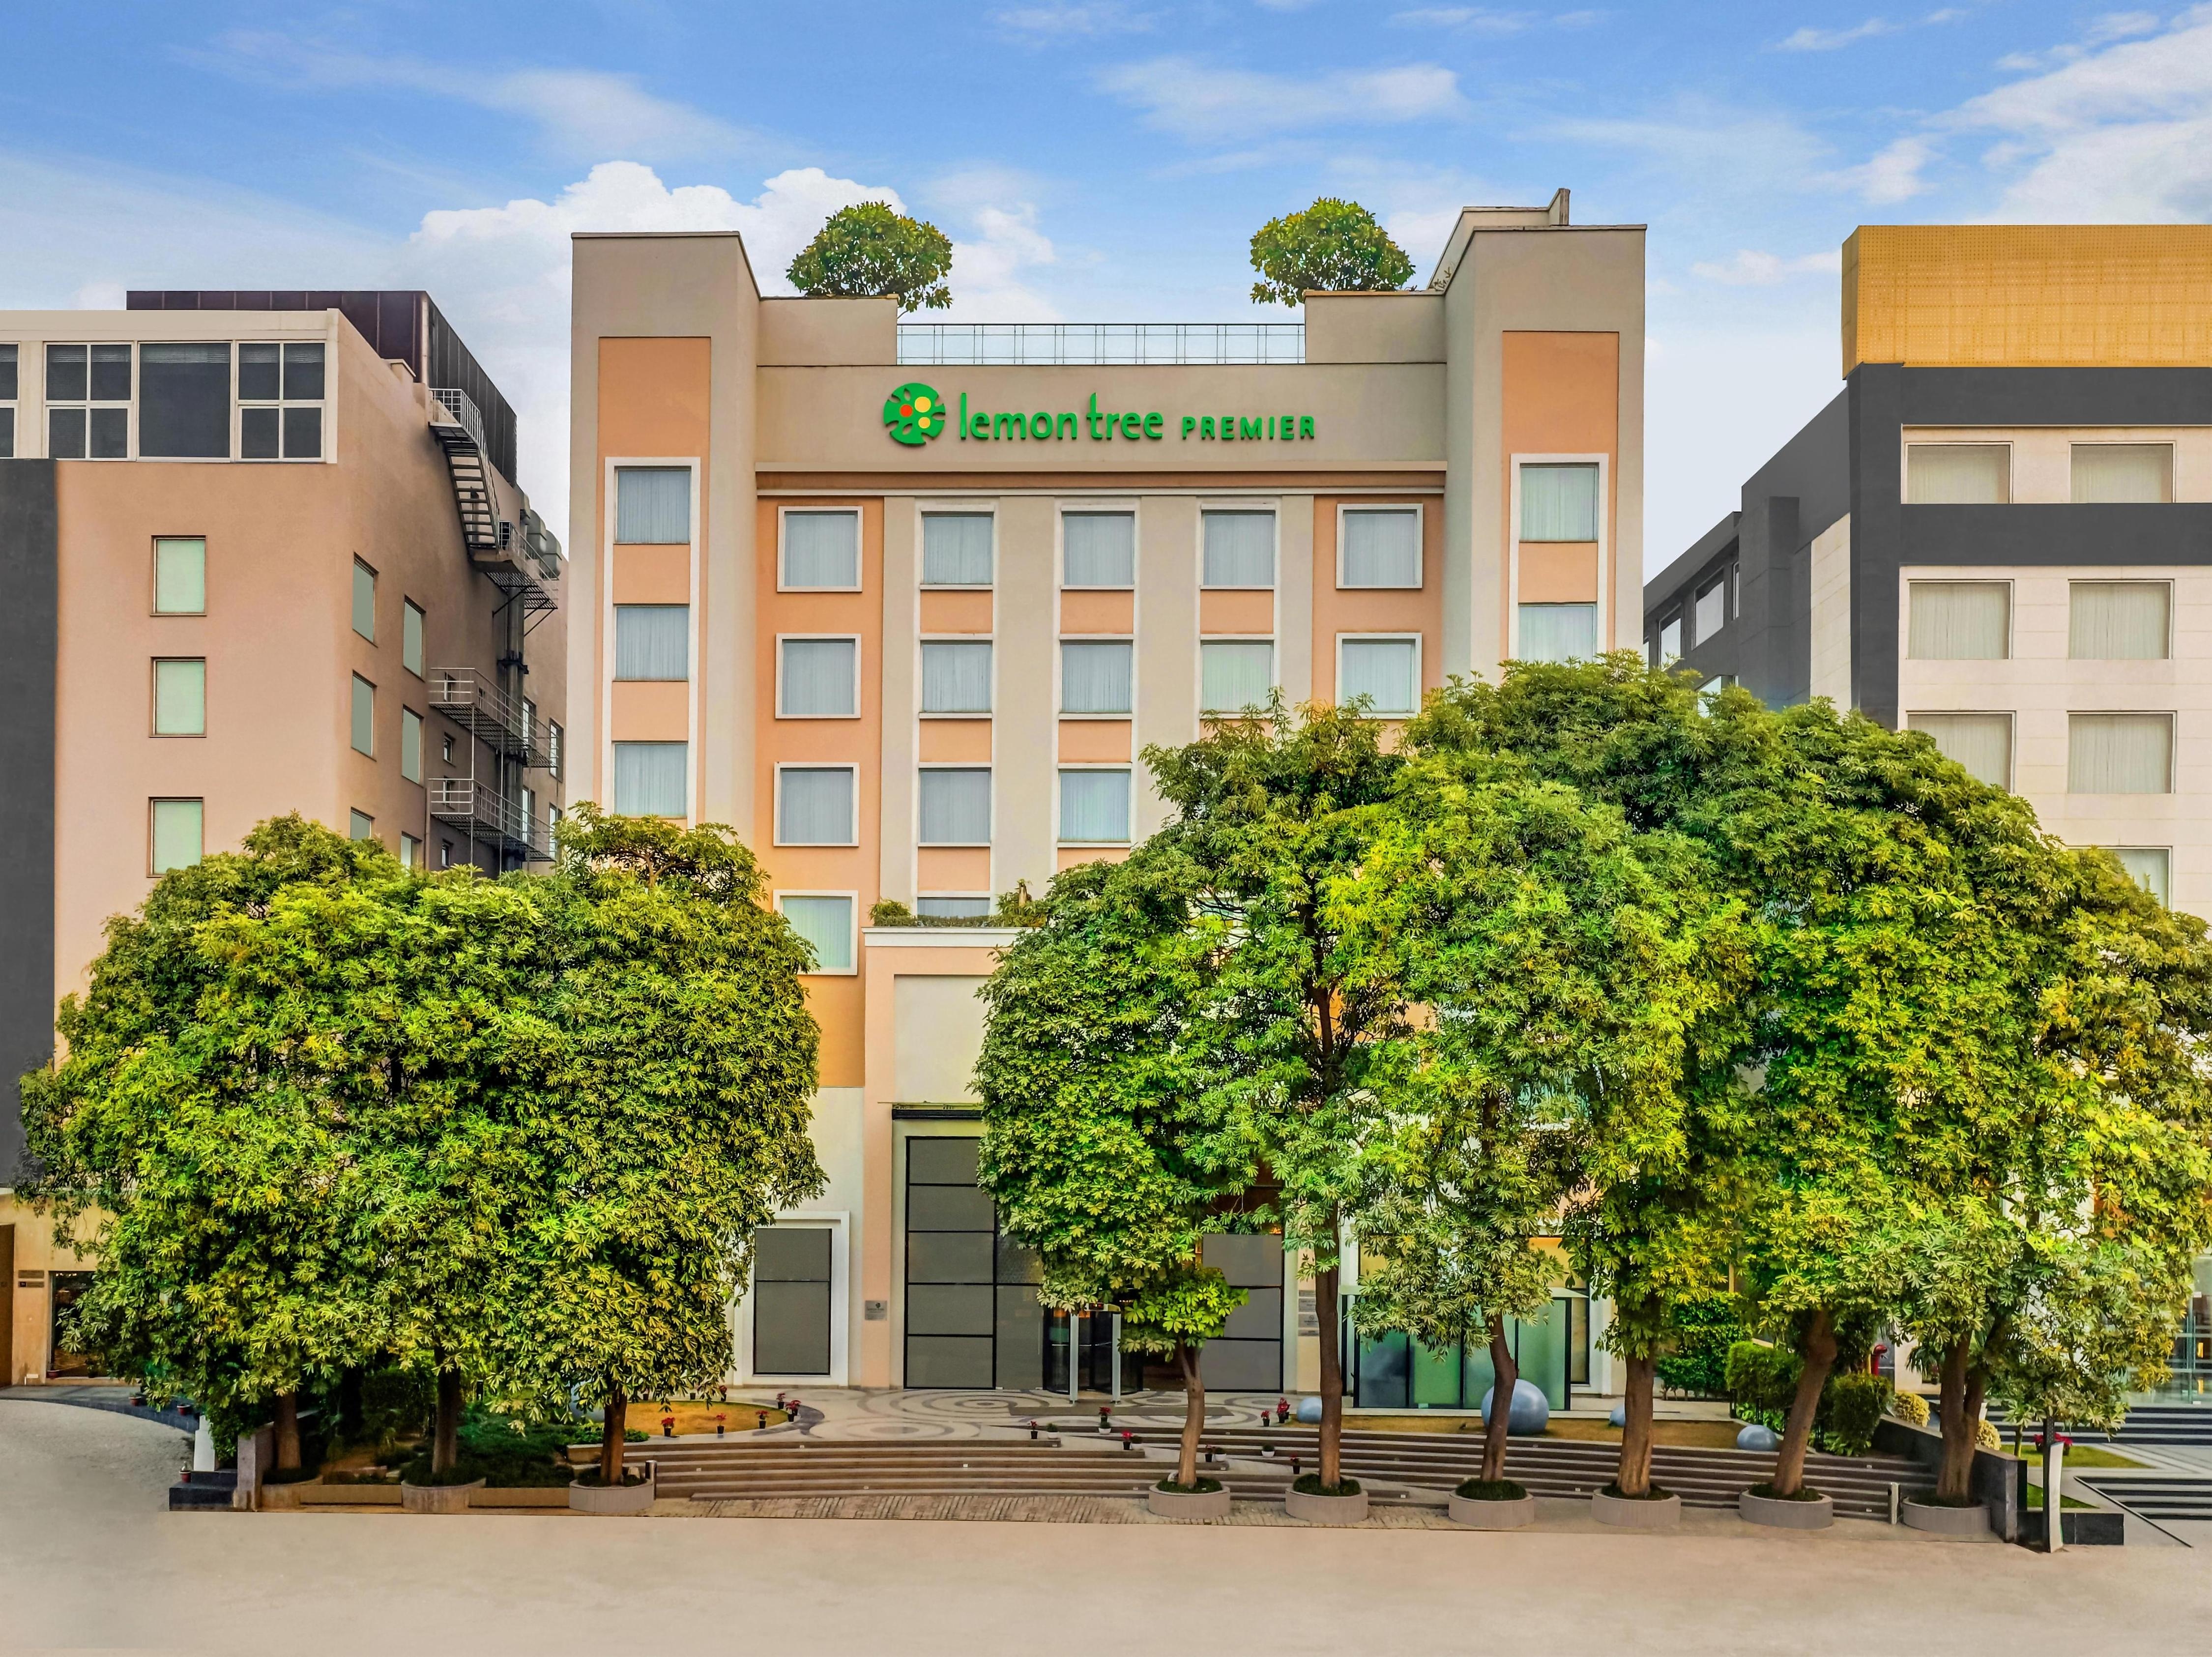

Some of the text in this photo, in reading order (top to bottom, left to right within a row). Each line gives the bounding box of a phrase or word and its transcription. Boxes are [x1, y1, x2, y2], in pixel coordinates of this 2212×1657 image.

[960, 392, 1314, 440] lemon tree PREMIER
